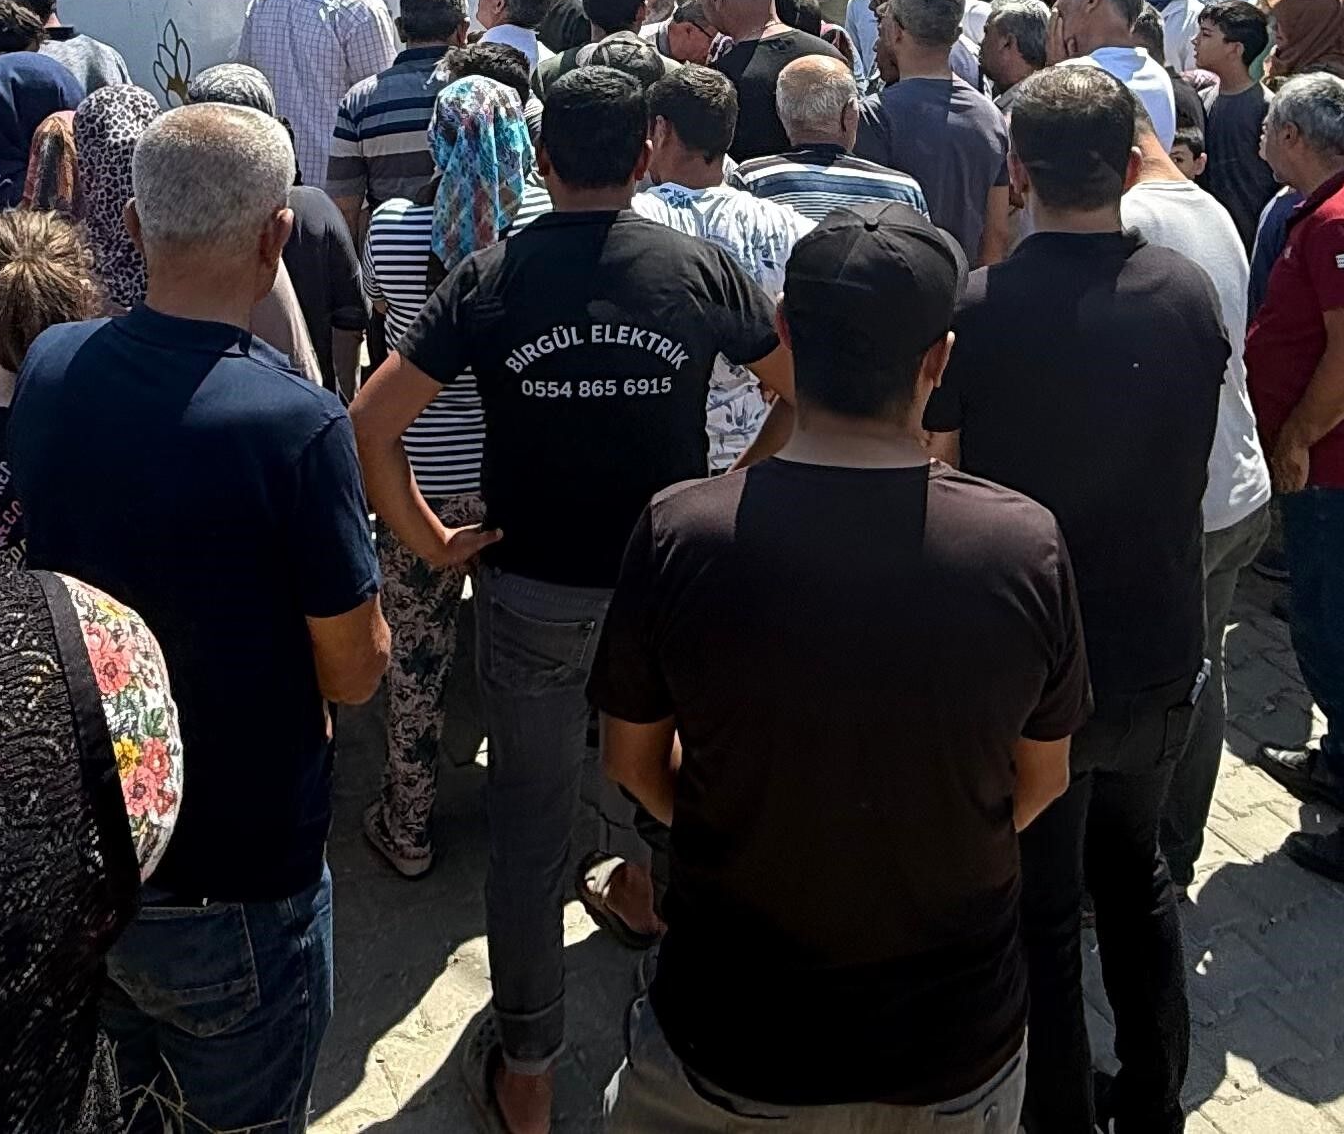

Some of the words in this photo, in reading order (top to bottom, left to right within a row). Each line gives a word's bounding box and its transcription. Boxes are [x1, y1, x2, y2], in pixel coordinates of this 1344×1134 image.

[505, 325, 584, 374] BİRGÜL
[591, 324, 690, 371] ELEKTRİK
[521, 379, 573, 399] 0554
[578, 379, 617, 398] 865
[623, 376, 673, 397] 6915
